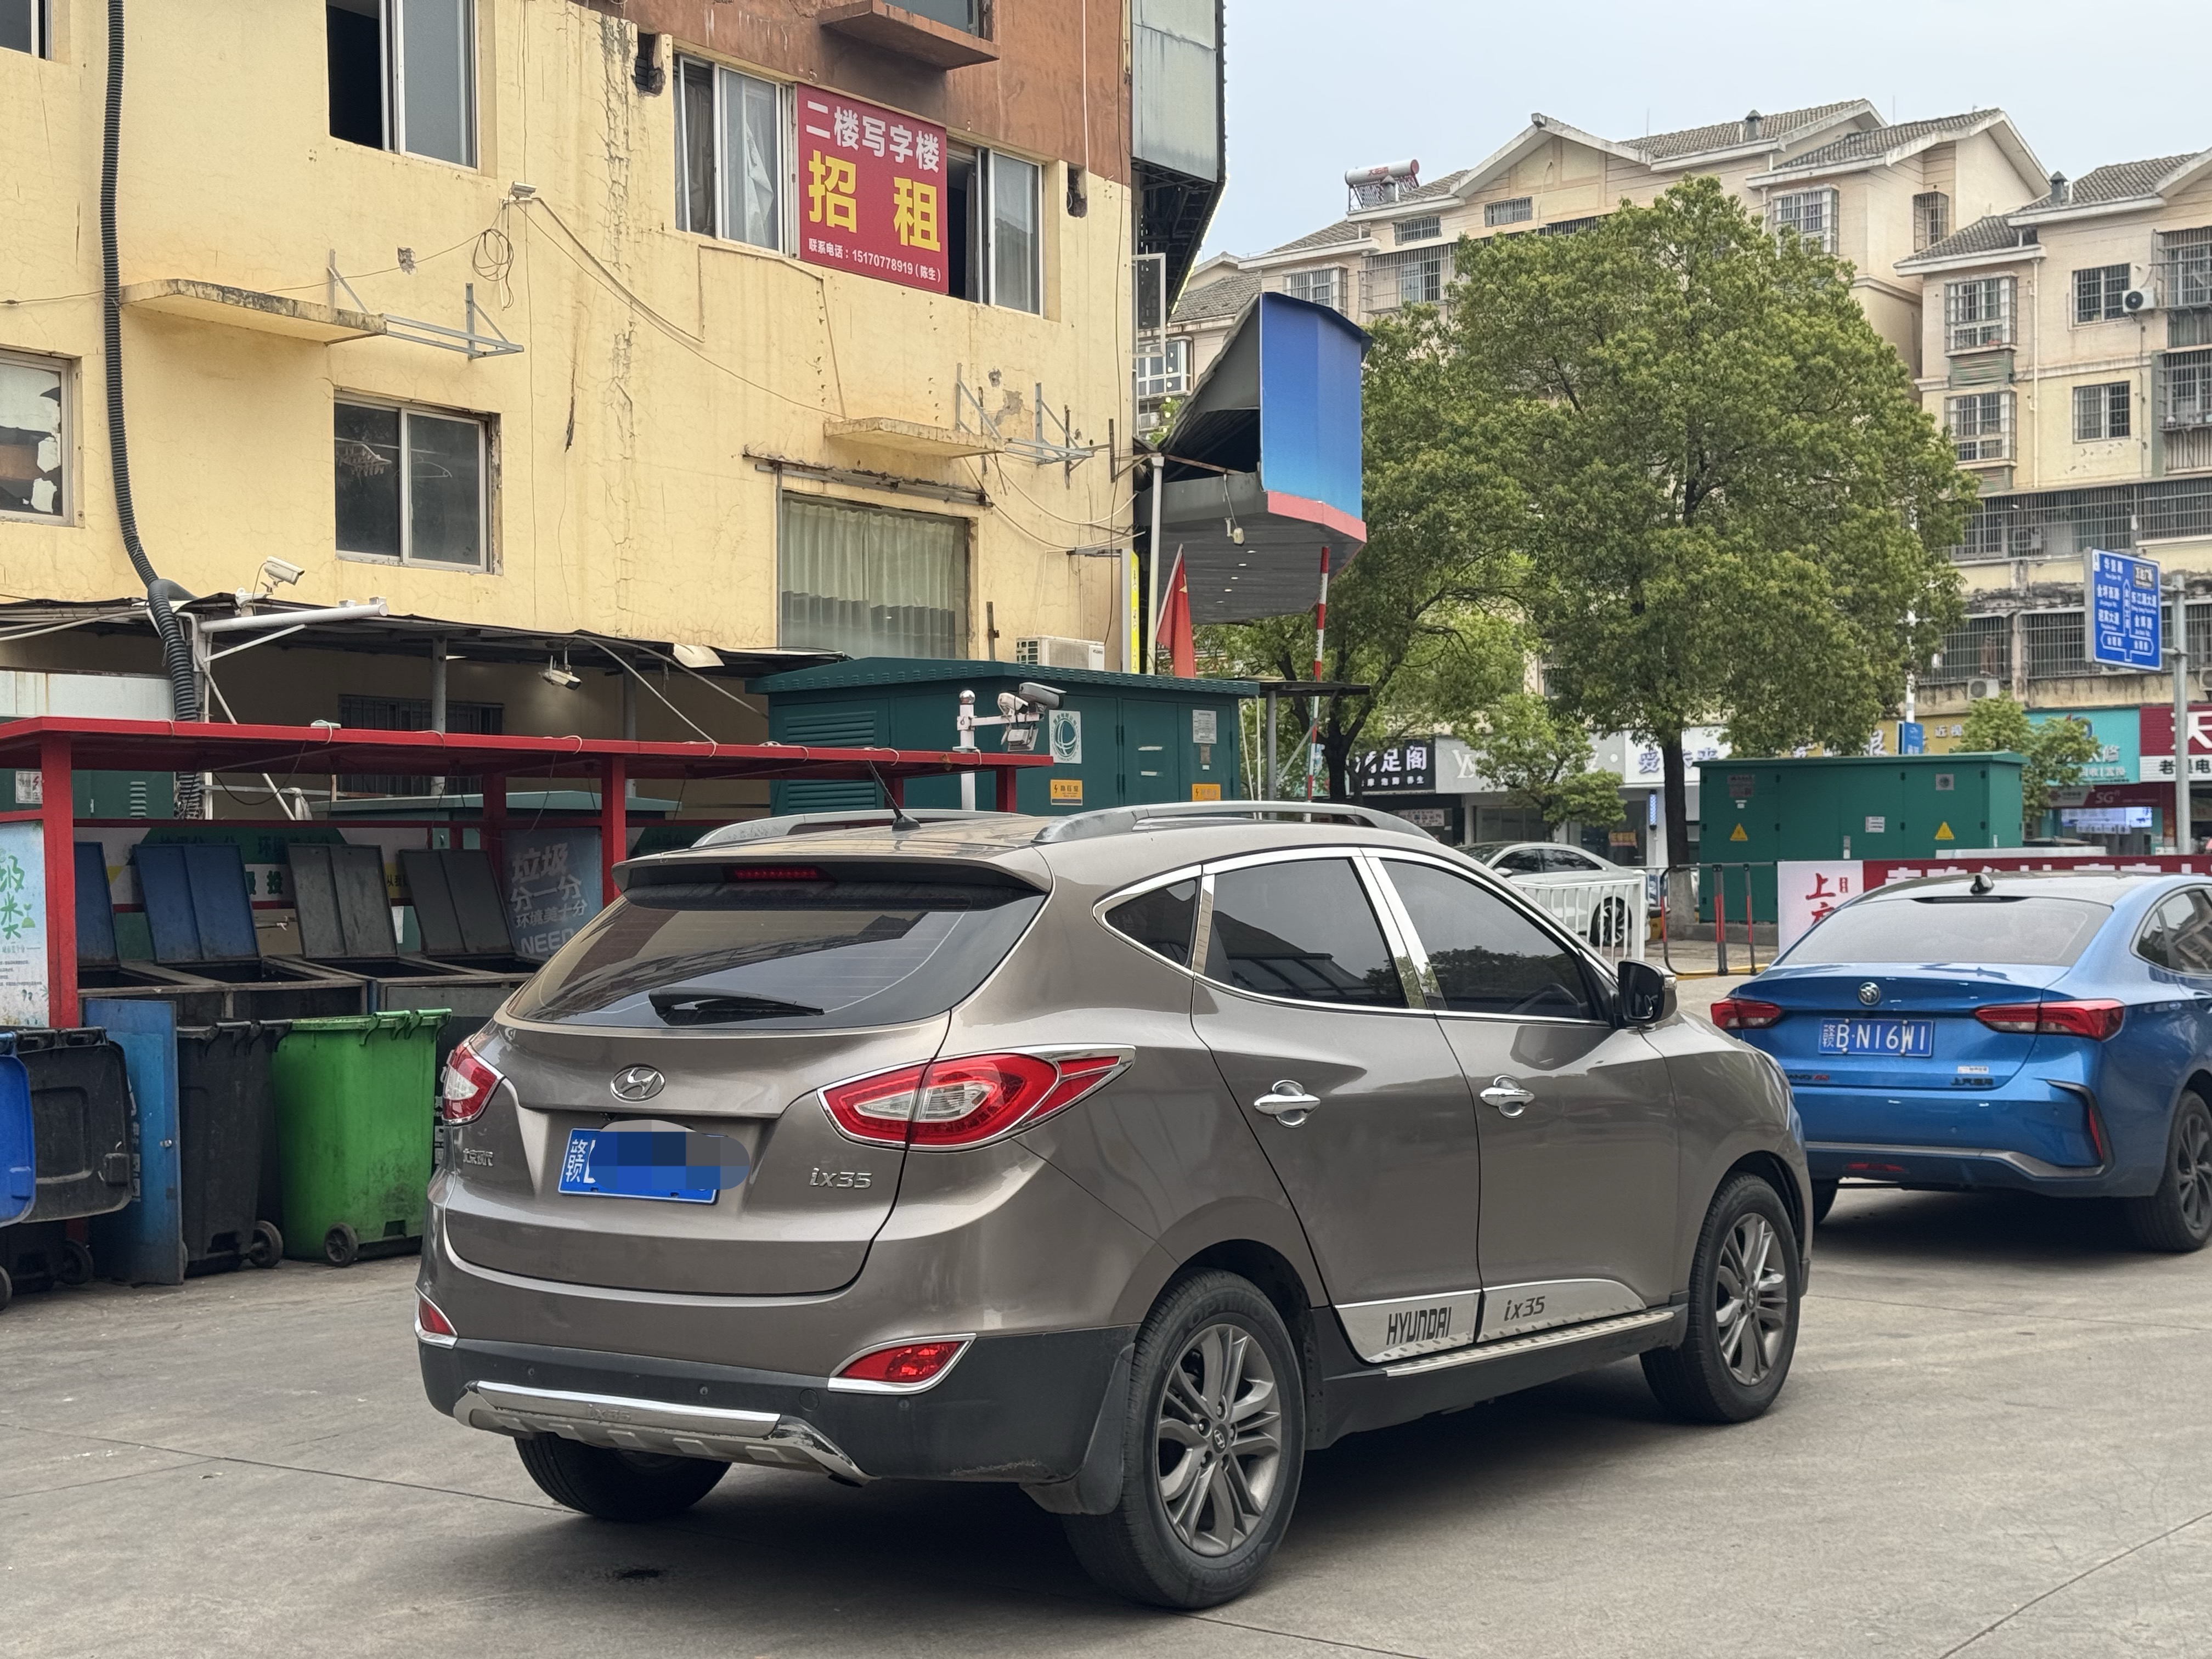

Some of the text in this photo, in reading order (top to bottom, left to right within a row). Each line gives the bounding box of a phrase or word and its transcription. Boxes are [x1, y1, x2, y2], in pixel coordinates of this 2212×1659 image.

[806, 100, 940, 173] 二楼写字楼
[511, 842, 568, 884] 垃圾
[510, 873, 582, 913] 分一分
[516, 899, 588, 928] 环境美十分
[809, 1167, 872, 1189] ix35
[1386, 1306, 1452, 1346] HYUNDAI
[1504, 1295, 1546, 1322] ix35
